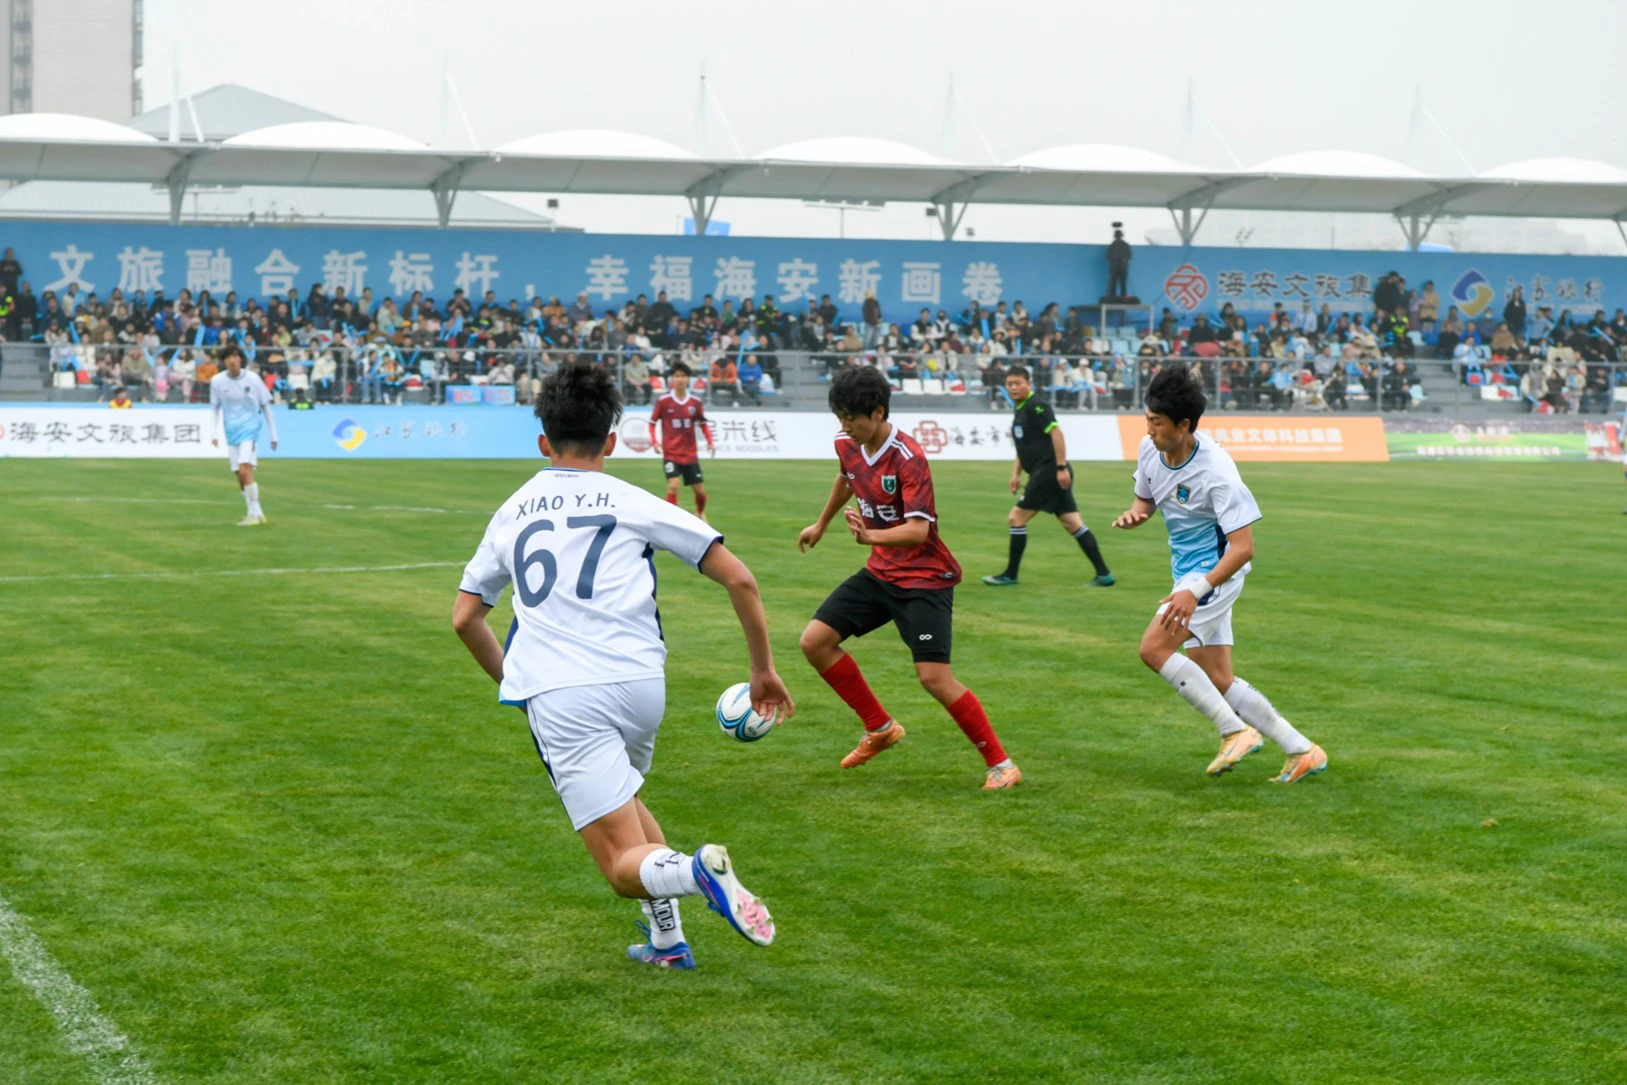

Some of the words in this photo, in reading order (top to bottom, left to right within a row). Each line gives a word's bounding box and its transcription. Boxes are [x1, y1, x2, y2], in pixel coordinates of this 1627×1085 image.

[1218, 270, 1404, 299] 海安文旅集
[9, 421, 201, 444] 海安文旅集团
[515, 495, 564, 521] XIAO
[575, 492, 617, 508] Y.H.
[513, 514, 617, 608] 67
